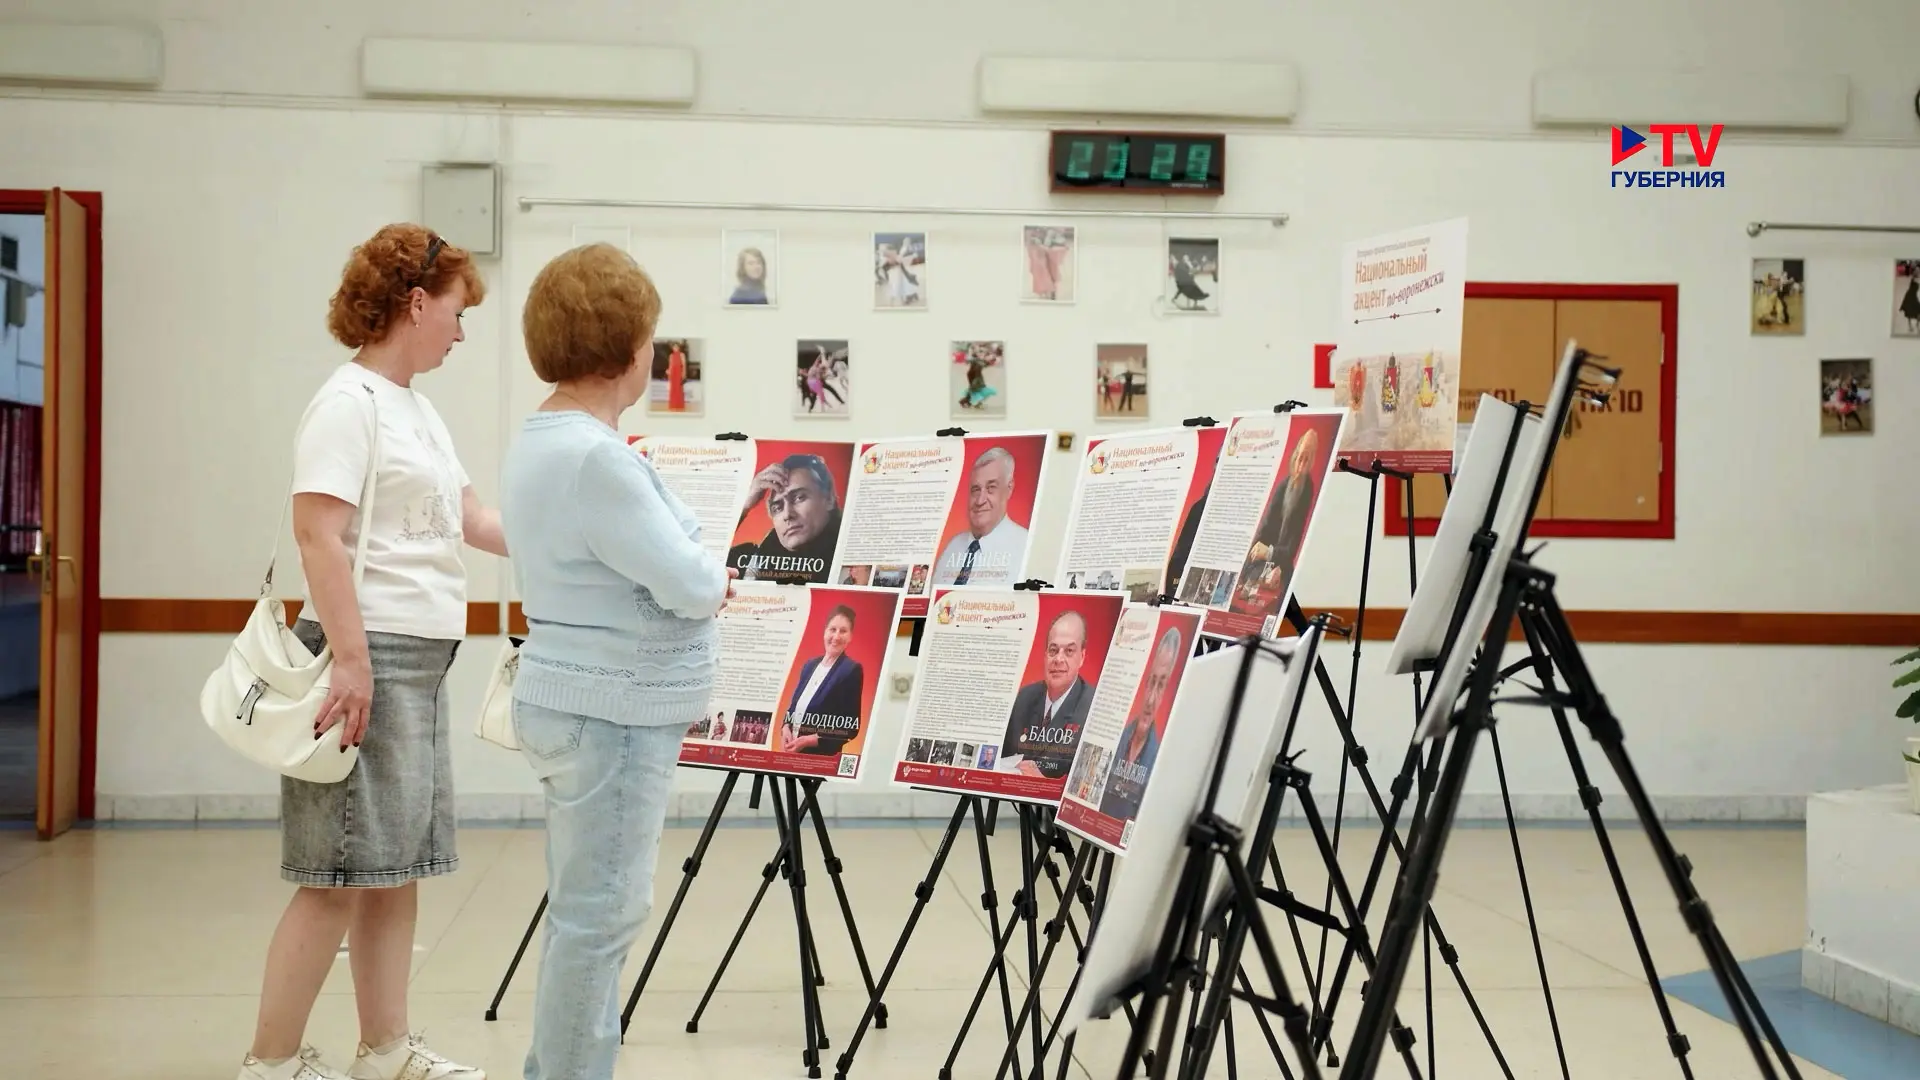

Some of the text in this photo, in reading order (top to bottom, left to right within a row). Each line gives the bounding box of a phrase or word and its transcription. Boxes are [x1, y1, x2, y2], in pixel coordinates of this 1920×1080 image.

[1355, 246, 1427, 284] Национальный
[1353, 288, 1386, 312] акцент
[1112, 443, 1173, 459] Национальный
[1110, 458, 1138, 470] акцент
[737, 553, 824, 573] СЛИЧЕНКО
[957, 600, 1015, 612] Национальный
[956, 613, 983, 623] акцент
[784, 711, 860, 730] МЛОДЦОВА
[1028, 725, 1073, 745] БАСОВ
